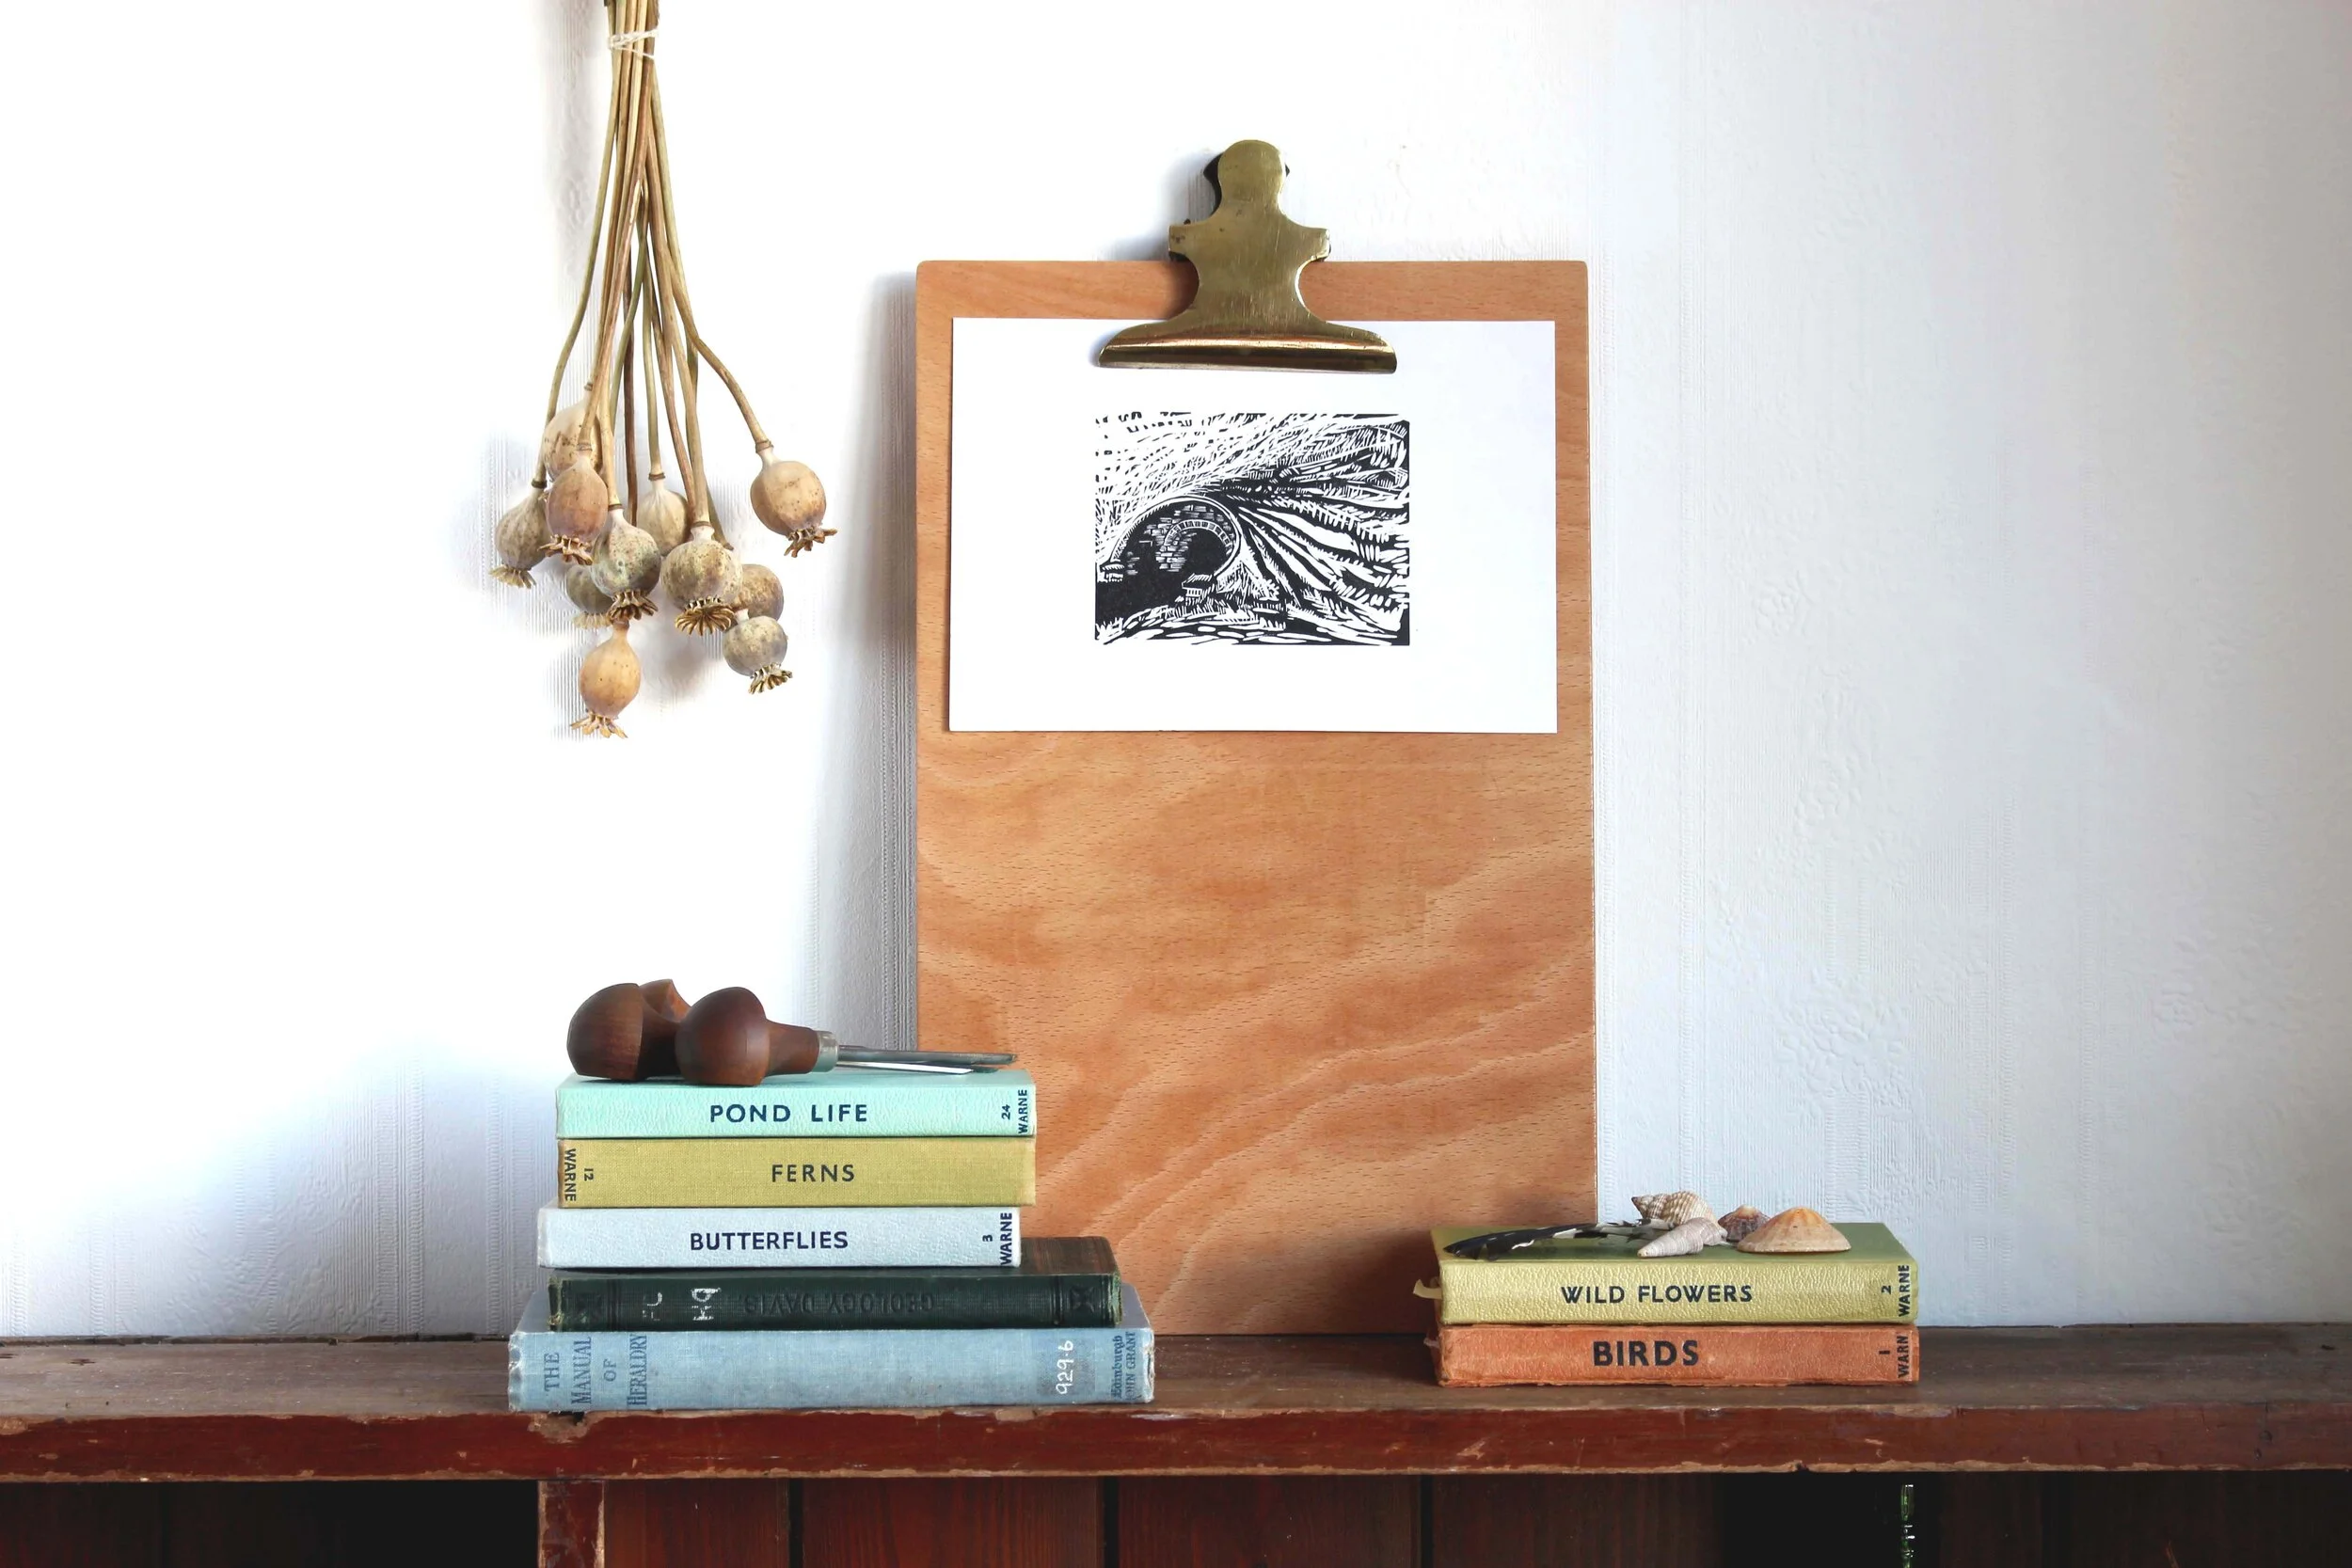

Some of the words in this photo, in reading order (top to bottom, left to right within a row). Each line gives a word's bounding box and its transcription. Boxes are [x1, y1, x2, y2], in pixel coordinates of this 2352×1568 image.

[710, 1103, 791, 1123] POND
[811, 1103, 867, 1122] LIFE
[1001, 1103, 1010, 1120] 24
[1017, 1089, 1028, 1134] WARNE
[564, 1148, 577, 1202] WARNE
[583, 1167, 595, 1181] 12
[771, 1164, 855, 1182] FERNS
[690, 1230, 849, 1251] BUTTERFLIES
[982, 1234, 993, 1243] 3
[999, 1212, 1012, 1265] WARNE
[1561, 1285, 1625, 1304] WILD
[1638, 1284, 1753, 1303] FLOWERS
[1882, 1285, 1891, 1295] 2
[1898, 1264, 1911, 1317] WARNE
[1124, 1331, 1136, 1370] GRANT
[1593, 1339, 1699, 1367] BIRDS
[544, 1352, 560, 1392] THE
[571, 1336, 592, 1405] MANUAL
[603, 1358, 617, 1383] OF
[627, 1334, 647, 1407] HERALDRY
[1110, 1334, 1124, 1400] Edinburgh
